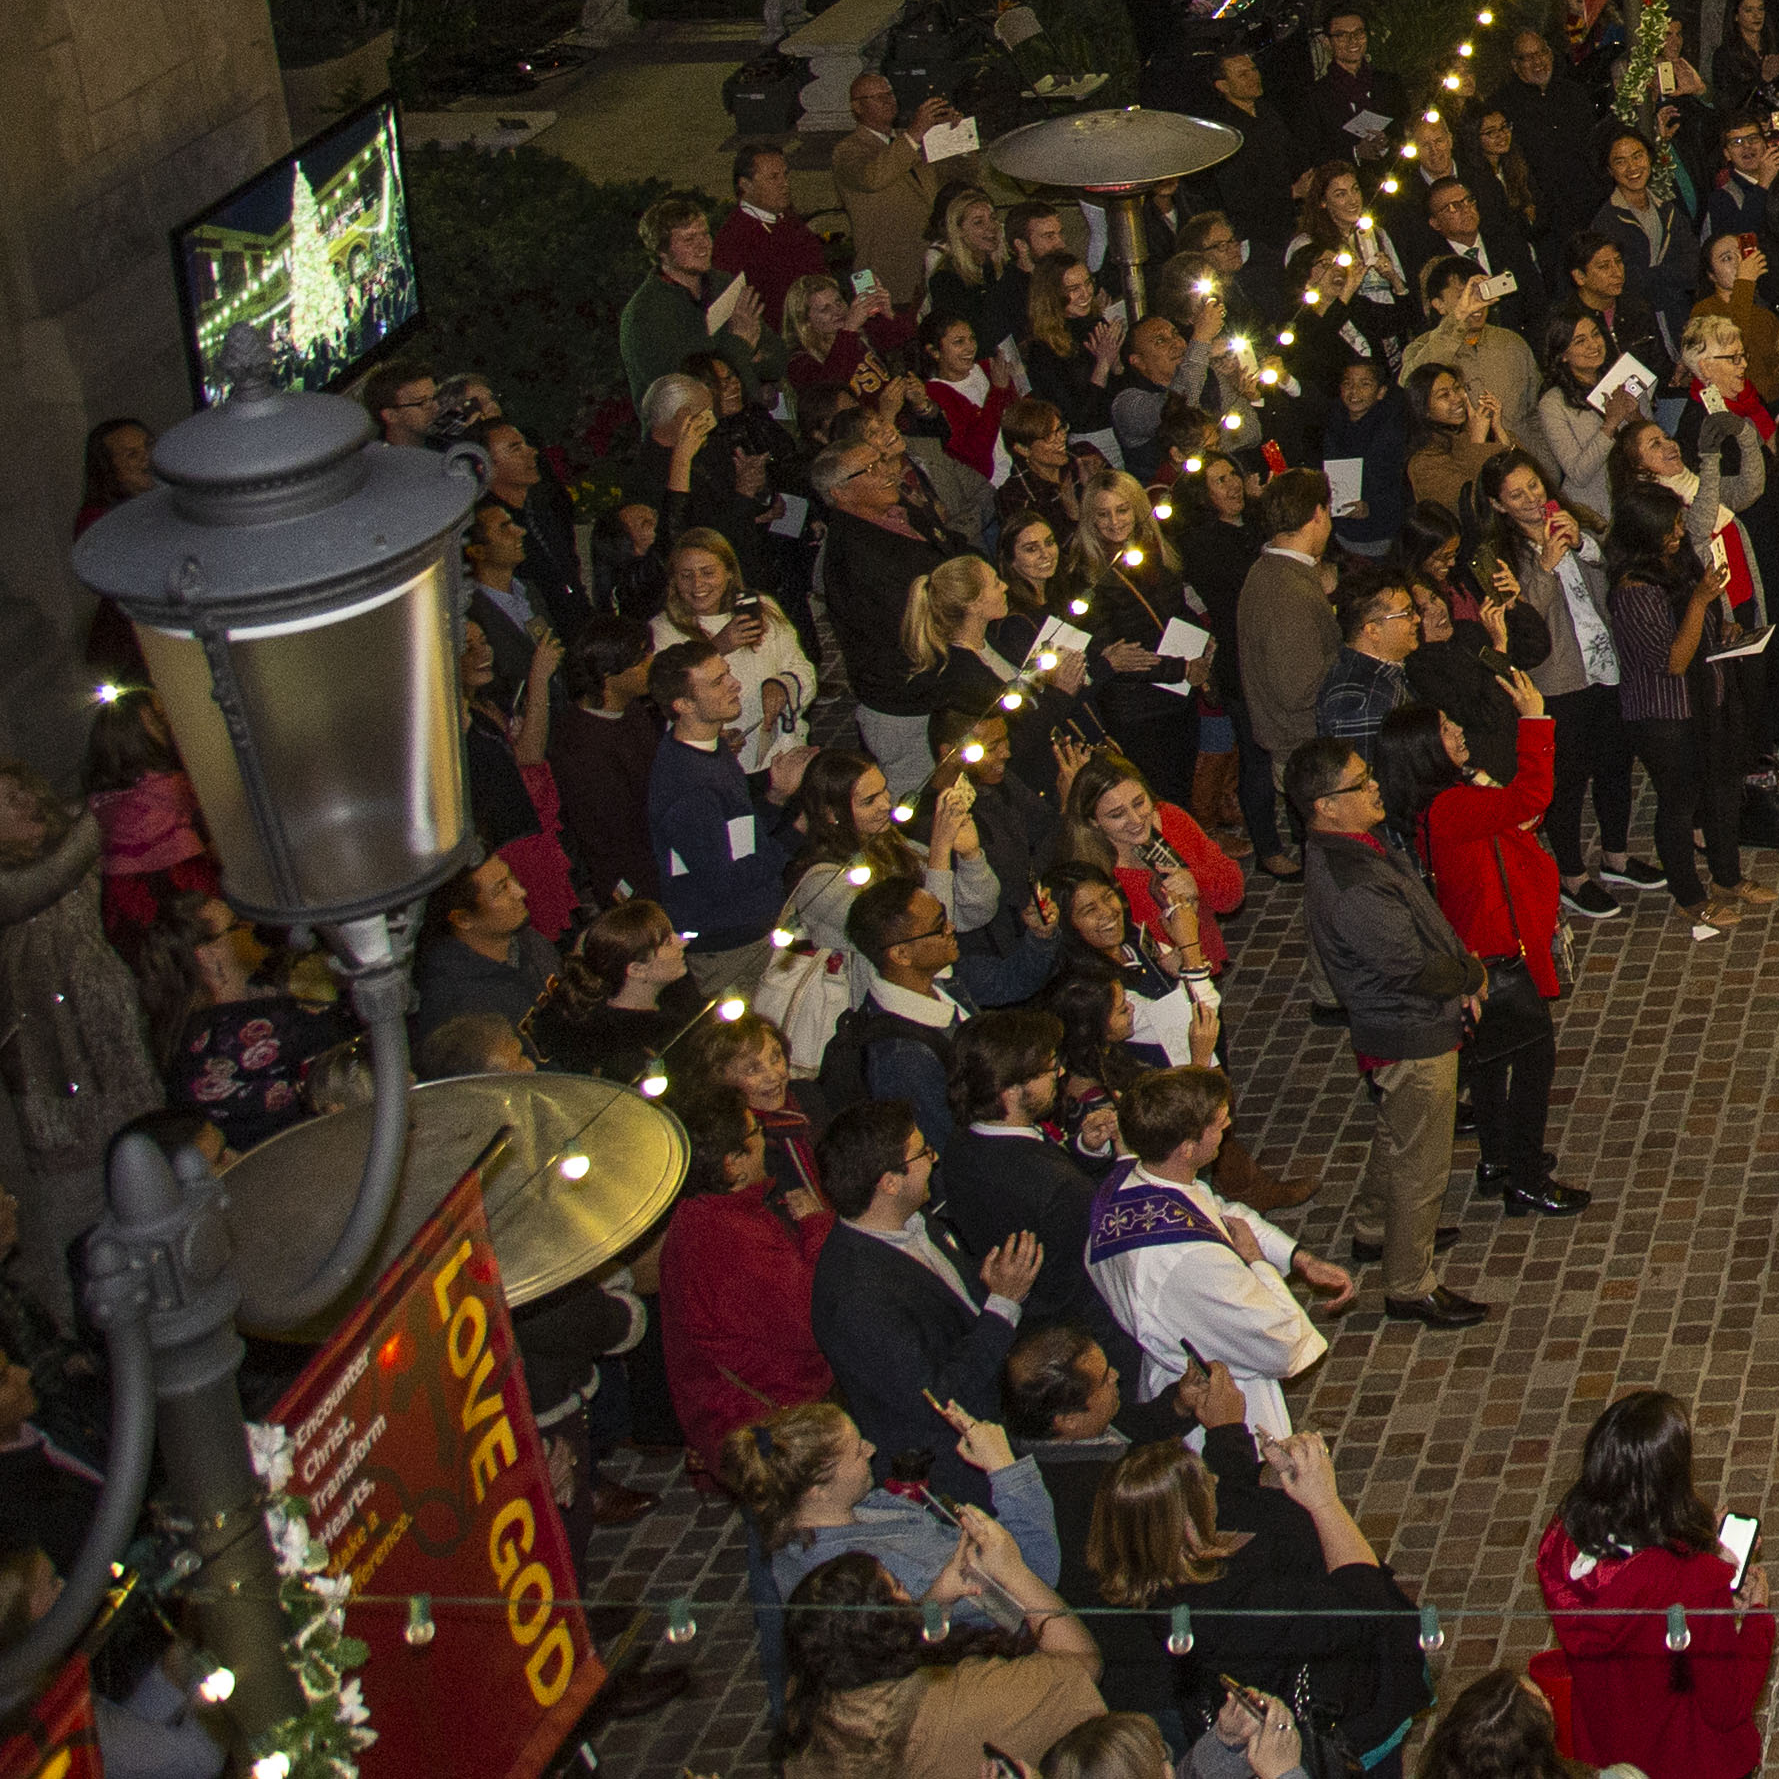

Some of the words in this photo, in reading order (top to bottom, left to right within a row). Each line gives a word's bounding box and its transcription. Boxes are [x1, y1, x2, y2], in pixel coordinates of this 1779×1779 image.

[295, 1347, 370, 1448] Encounter
[303, 1416, 356, 1483] Christ,
[311, 1414, 387, 1516] Transform
[434, 1240, 518, 1499] LOVE
[489, 1499, 575, 1707] GOD
